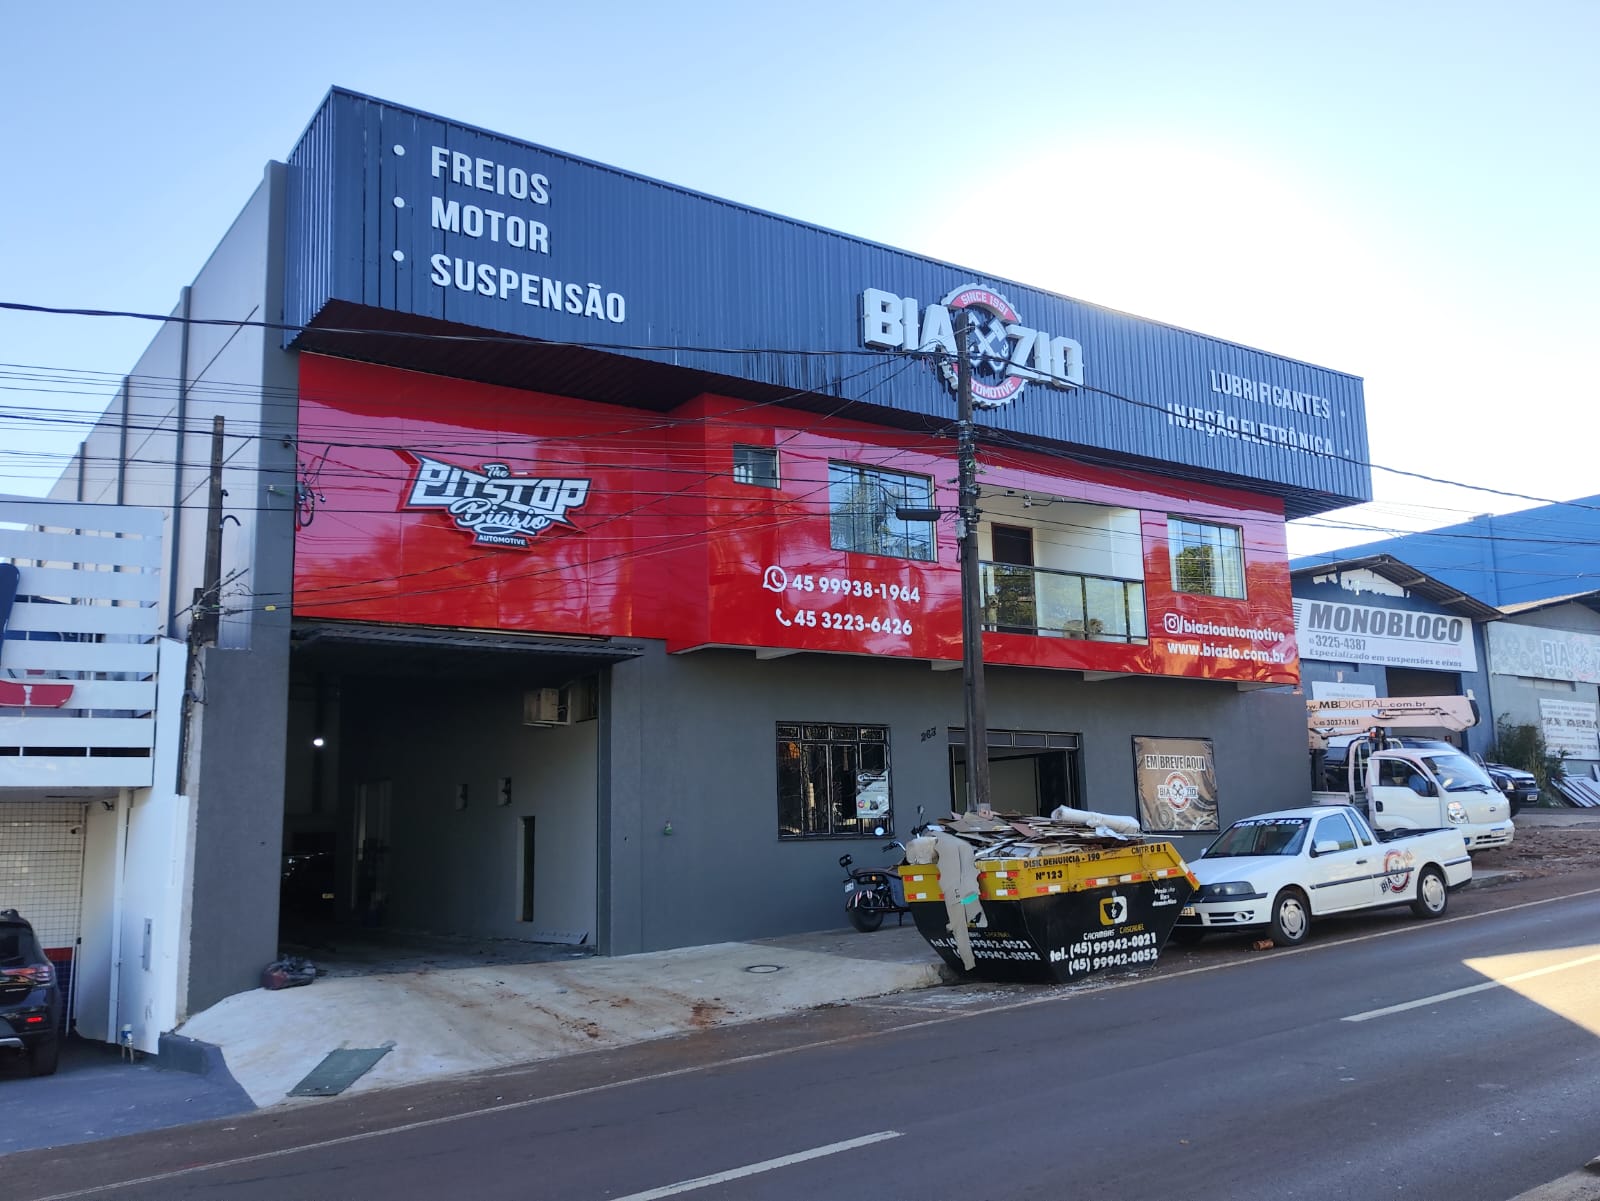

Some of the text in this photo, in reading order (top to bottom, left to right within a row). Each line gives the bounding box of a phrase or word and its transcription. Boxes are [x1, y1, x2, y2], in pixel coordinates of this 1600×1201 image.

[431, 145, 549, 205] FREIOS
[431, 196, 549, 254] MOTOR
[430, 253, 626, 323] SUSPENSÃO
[961, 292, 987, 305] SINCE
[1210, 369, 1331, 419] LUBRIFICANTES
[1168, 402, 1335, 459] INJEÇÃO ELETRÔNICA
[482, 463, 510, 478] The
[478, 534, 526, 546] AUTOMOTIVE
[792, 574, 921, 603] 45 99938-1964
[794, 609, 913, 636] 45 3223-6426
[1308, 603, 1463, 643] MONOBLOCO
[1167, 641, 1285, 664] www.biazio.com.br
[1315, 634, 1366, 650] 3225-4387
[1309, 649, 1370, 661] Especializado
[1386, 654, 1434, 666] suspensões
[920, 727, 937, 744] 263
[1145, 755, 1205, 770] EM BREVE AQUI
[1024, 859, 1041, 869] DISK
[1043, 856, 1080, 866] DENUNCIA
[1087, 853, 1101, 861] 190
[973, 950, 1041, 960] 99942-0052
[1050, 932, 1157, 962] tel. (45) 99942-0021
[1068, 948, 1158, 975] (45) 99942-0052
